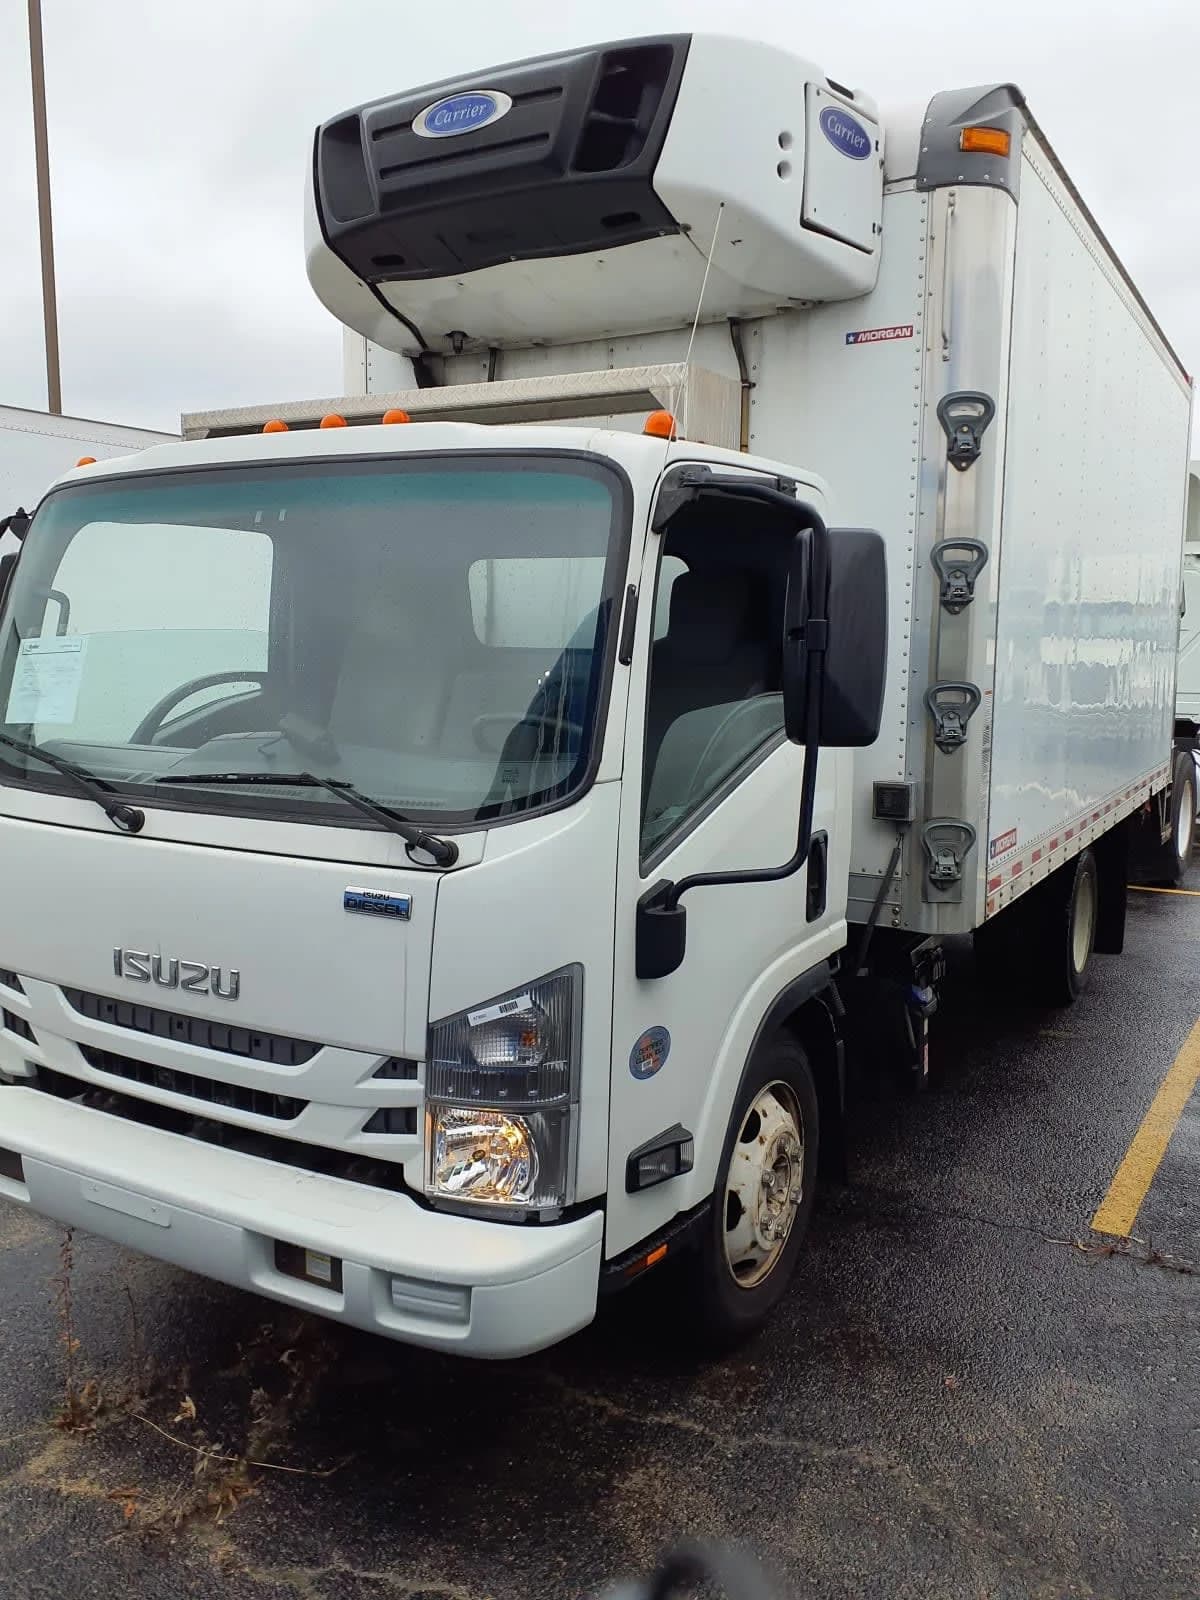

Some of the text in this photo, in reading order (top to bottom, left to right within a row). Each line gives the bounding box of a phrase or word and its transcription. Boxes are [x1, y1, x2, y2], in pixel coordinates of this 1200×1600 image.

[433, 103, 488, 126] Carrier
[827, 115, 866, 149] Carrier
[857, 327, 911, 342] MORGAN
[362, 891, 391, 901] ISUZU
[345, 897, 407, 918] DIESEL
[113, 946, 240, 1001] ISUZU
